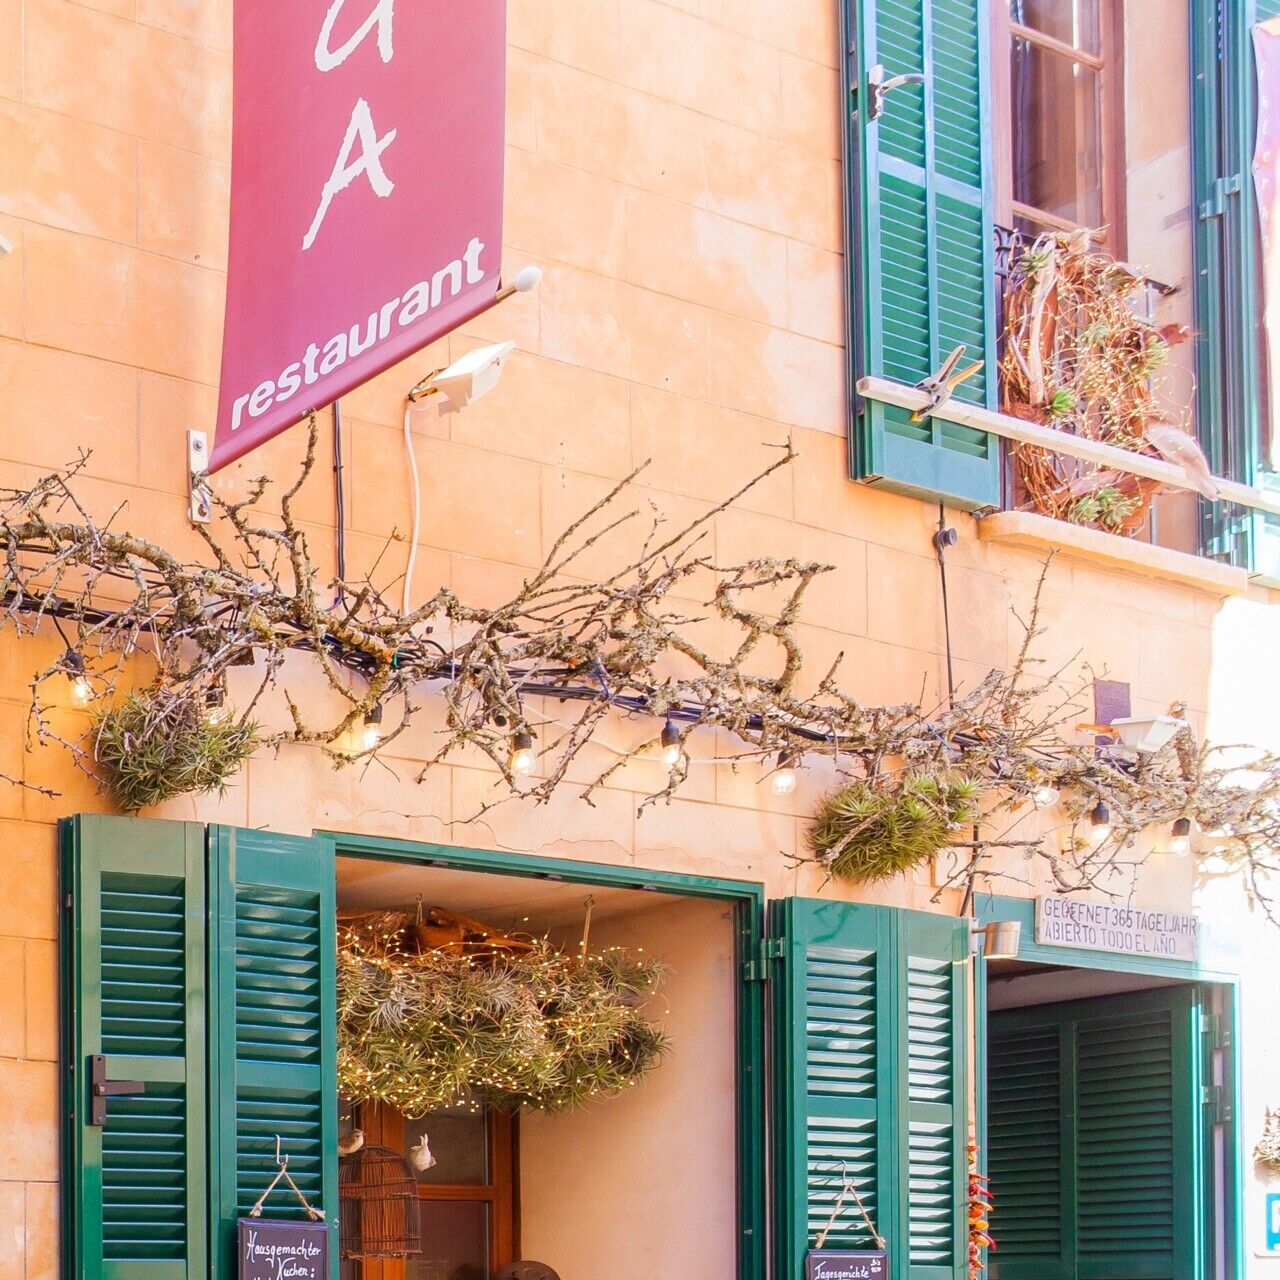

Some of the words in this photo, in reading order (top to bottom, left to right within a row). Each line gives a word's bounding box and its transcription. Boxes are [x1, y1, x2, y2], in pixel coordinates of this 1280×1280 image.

[231, 237, 485, 431] restaurant
[1044, 921, 1097, 945] ABIERTO
[1101, 928, 1133, 950] TODO
[1135, 934, 1150, 953] EL
[1112, 908, 1133, 929] 365
[1135, 911, 1163, 932] TAGE
[246, 1229, 322, 1268] Hausgemachter
